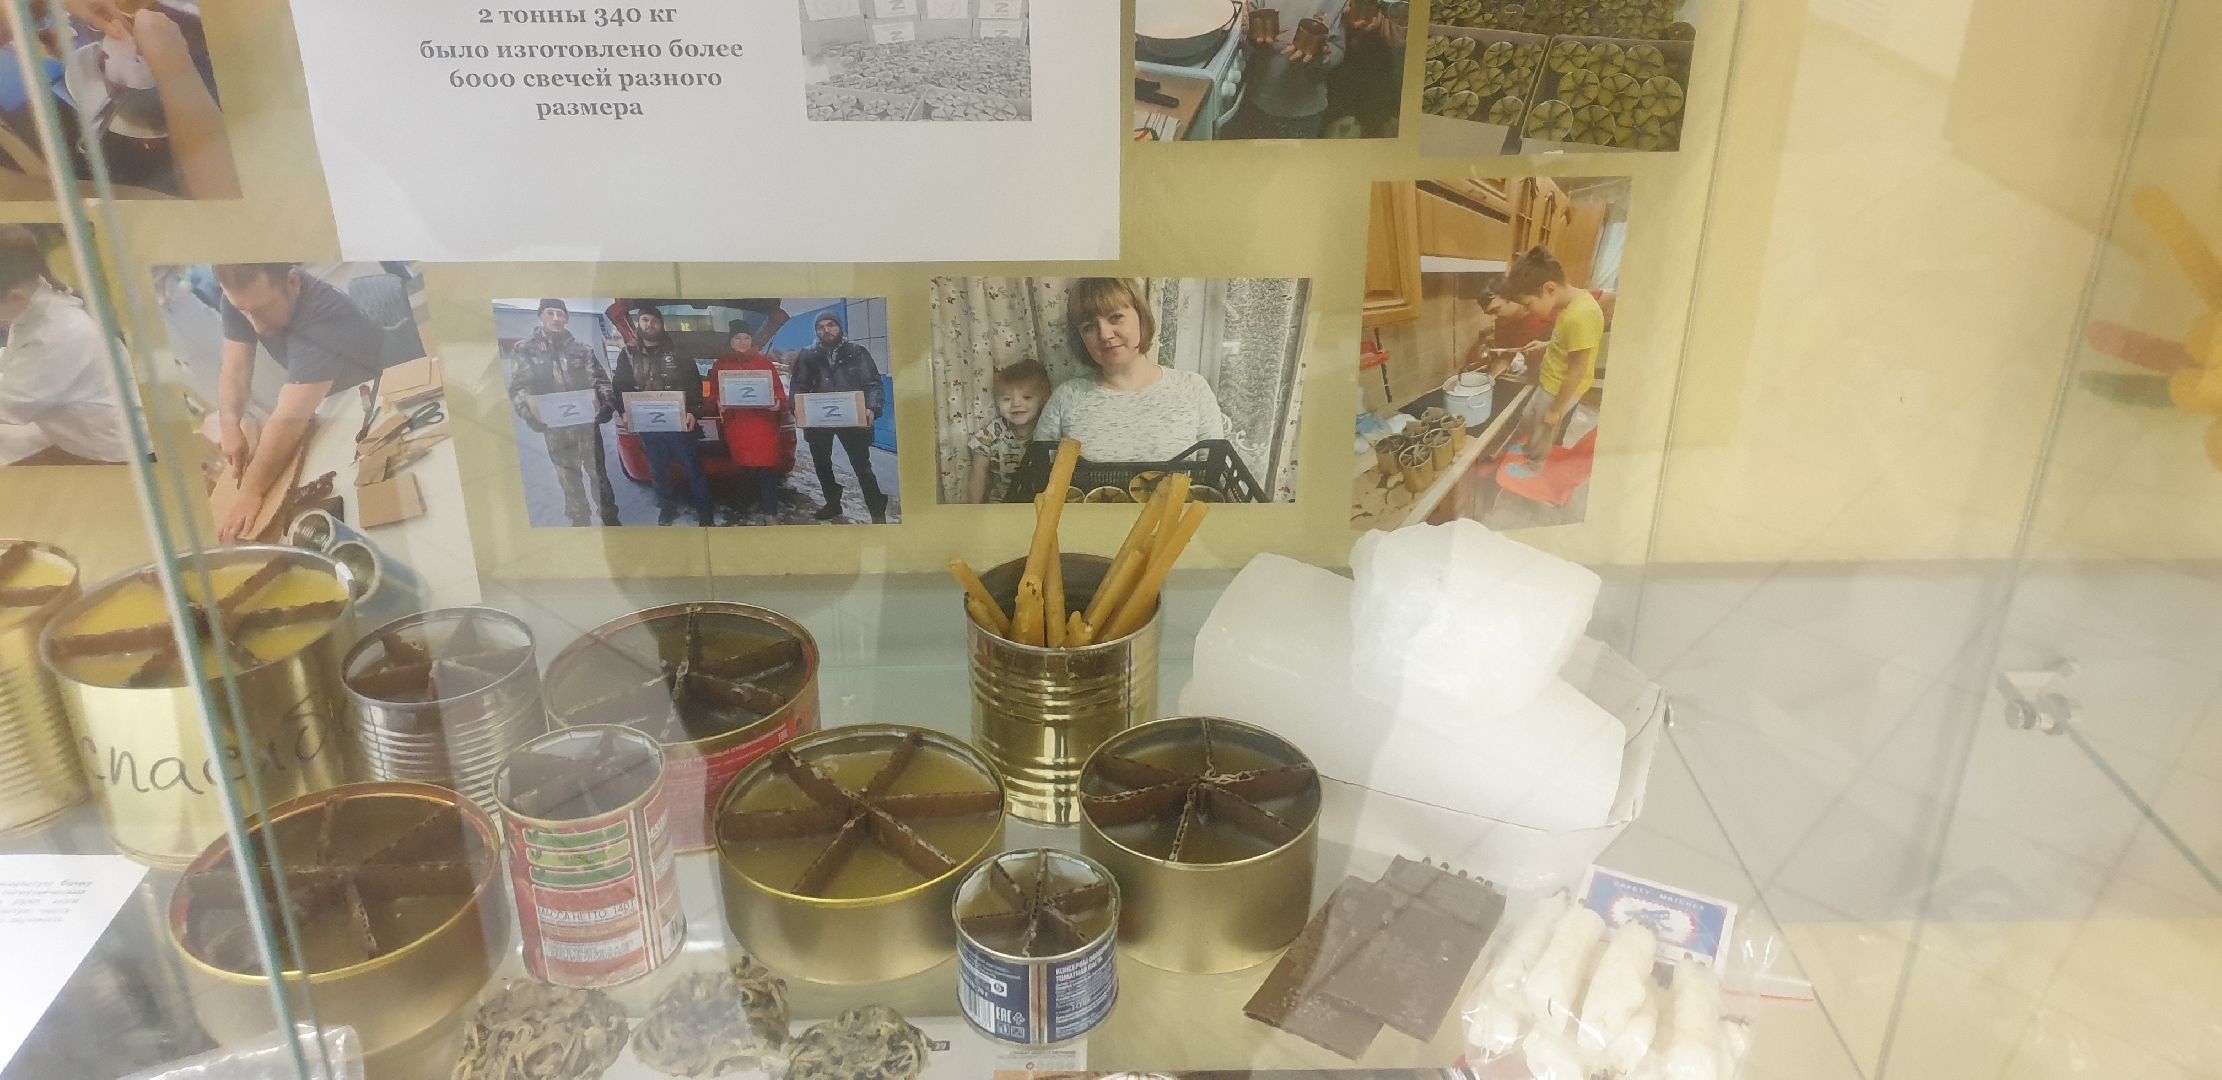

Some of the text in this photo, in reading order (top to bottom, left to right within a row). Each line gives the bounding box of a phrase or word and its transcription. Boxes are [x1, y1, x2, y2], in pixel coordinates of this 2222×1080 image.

[478, 7, 678, 28] 2 тонны 340 кг
[419, 38, 744, 59] было изготовлено более
[449, 67, 722, 92] 6000 свечей разного
[535, 101, 644, 121] размера
